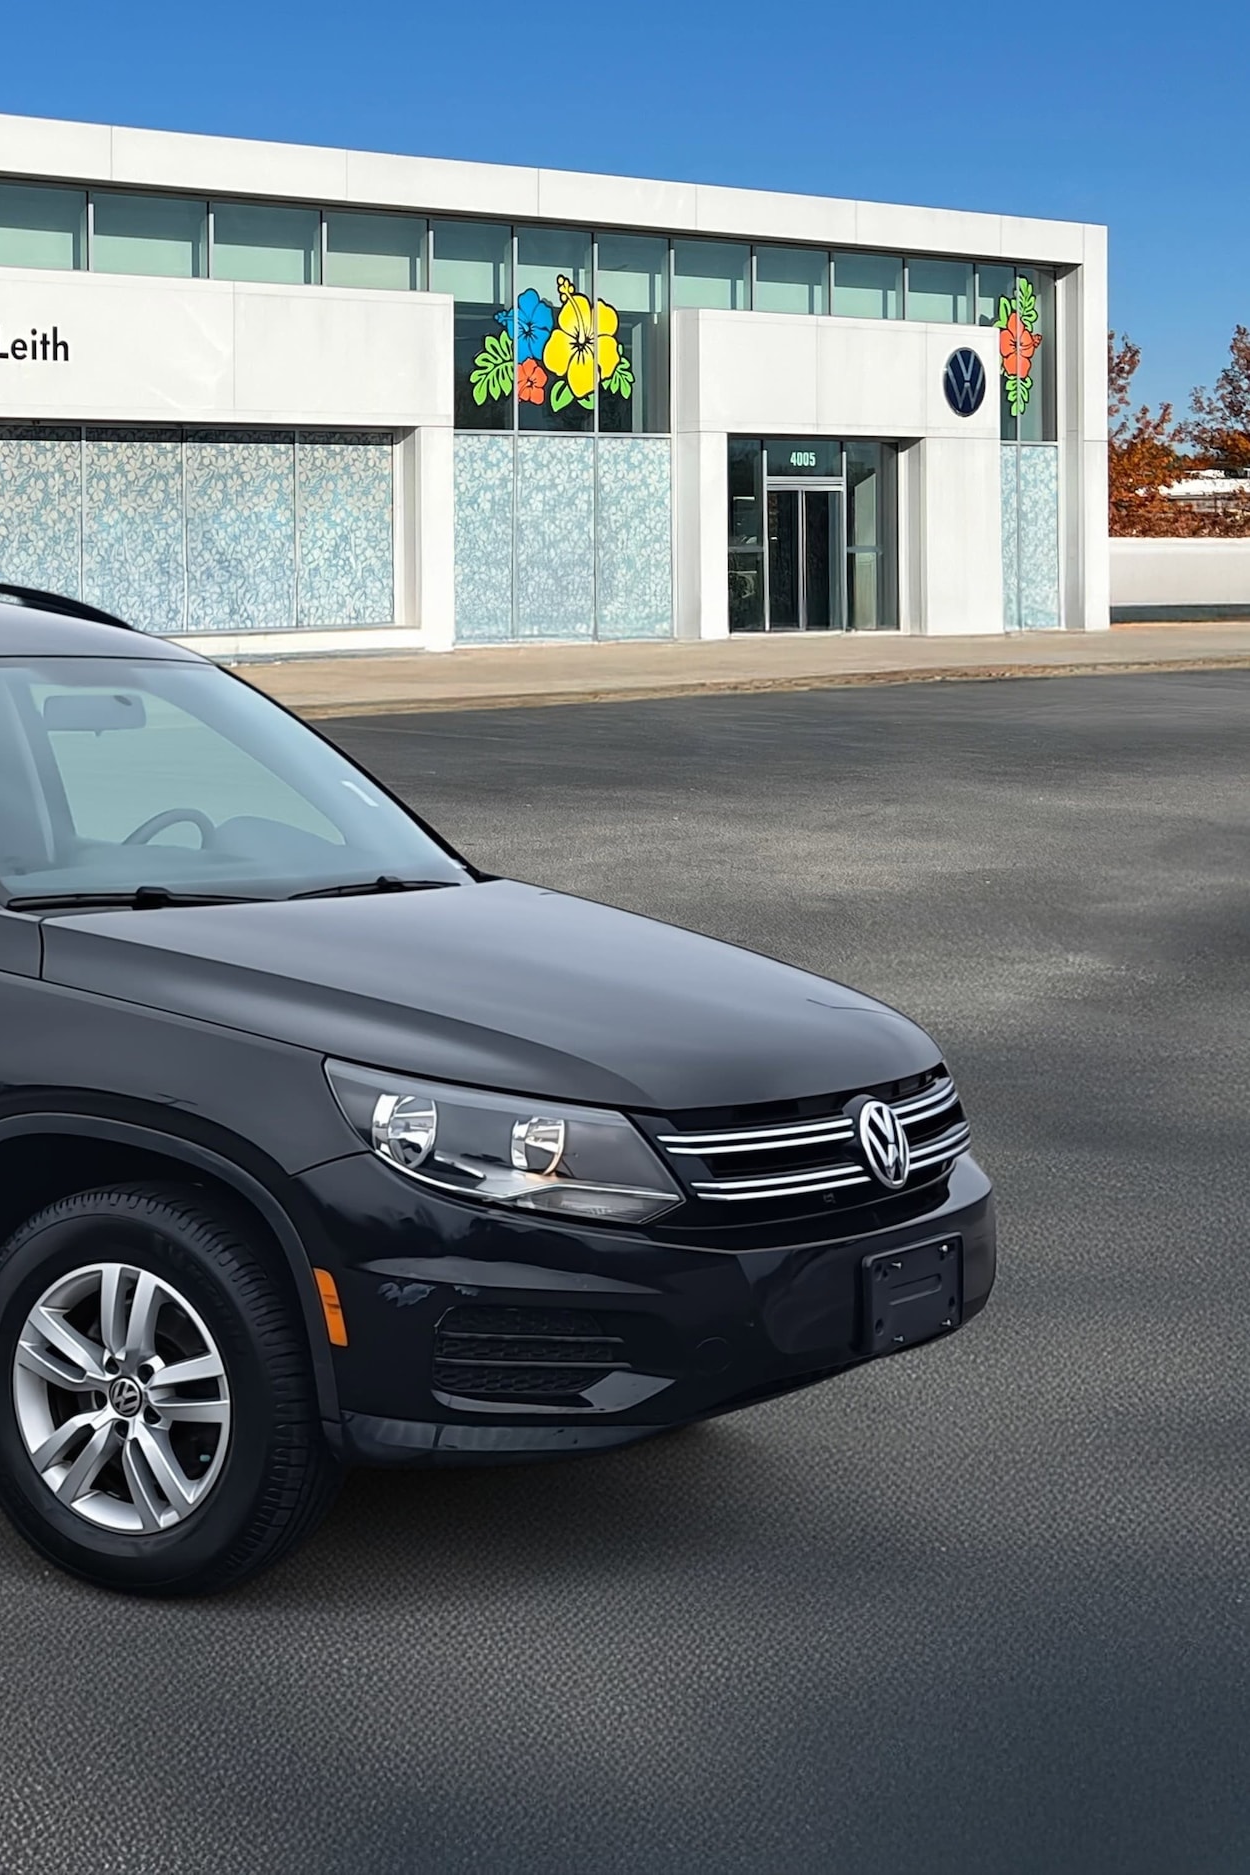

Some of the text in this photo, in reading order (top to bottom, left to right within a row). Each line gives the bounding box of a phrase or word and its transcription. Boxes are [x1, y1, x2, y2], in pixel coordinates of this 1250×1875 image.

[945, 348, 986, 415] VW
[790, 451, 816, 466] 4005
[862, 1102, 909, 1187] VW
